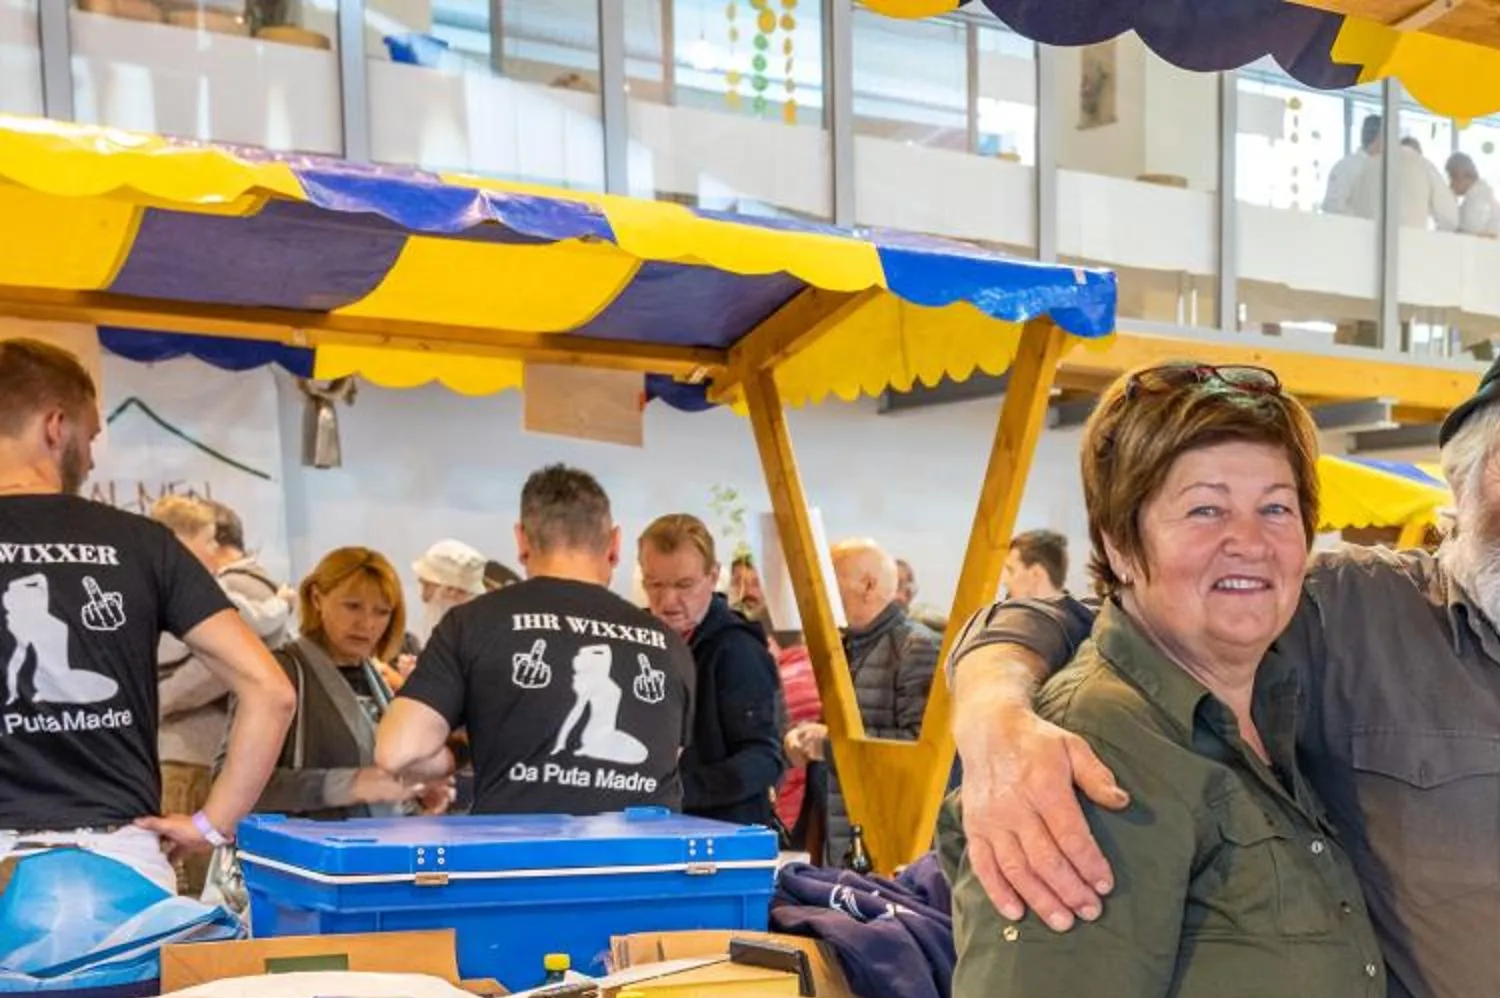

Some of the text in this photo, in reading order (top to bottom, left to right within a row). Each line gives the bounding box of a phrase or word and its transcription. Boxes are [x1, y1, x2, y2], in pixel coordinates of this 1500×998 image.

[512, 613, 668, 650] IHR WIXXER
[543, 763, 591, 787] Puta
[594, 767, 658, 792] Madre
